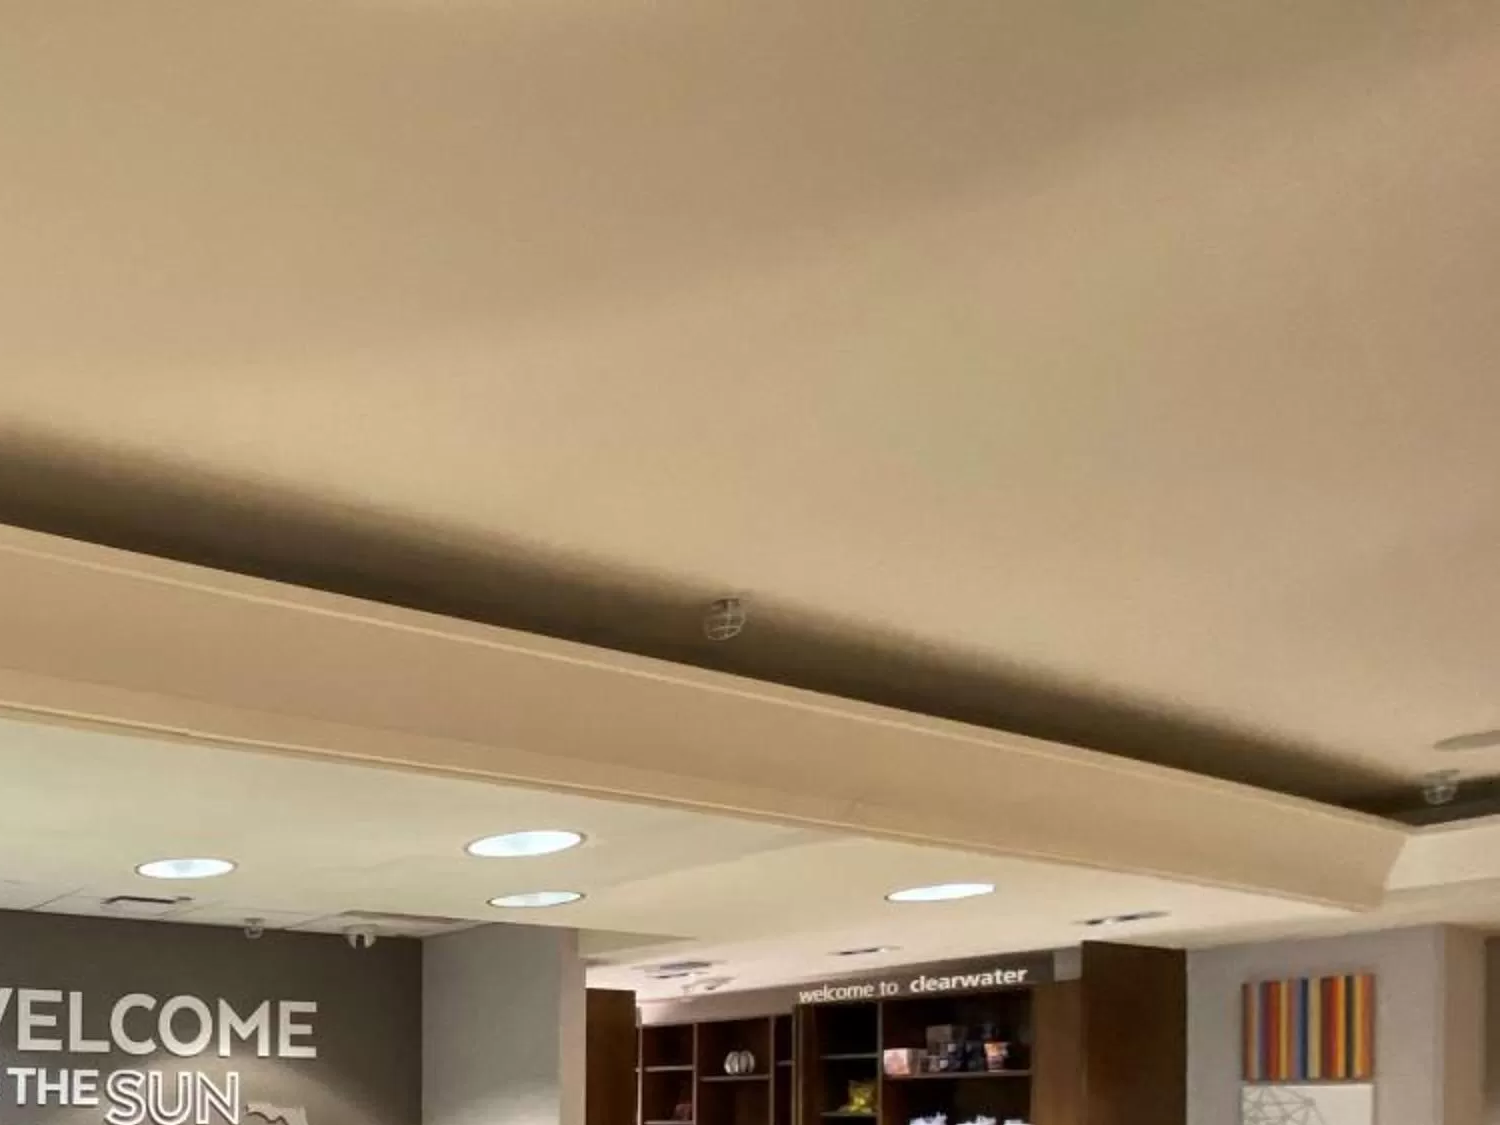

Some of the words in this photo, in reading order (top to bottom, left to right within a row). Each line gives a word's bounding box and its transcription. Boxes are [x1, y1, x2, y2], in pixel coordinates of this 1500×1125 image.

[799, 984, 874, 1003] welcome
[880, 981, 898, 996] to
[909, 968, 1028, 993] clearwater
[7, 1067, 99, 1105] THE
